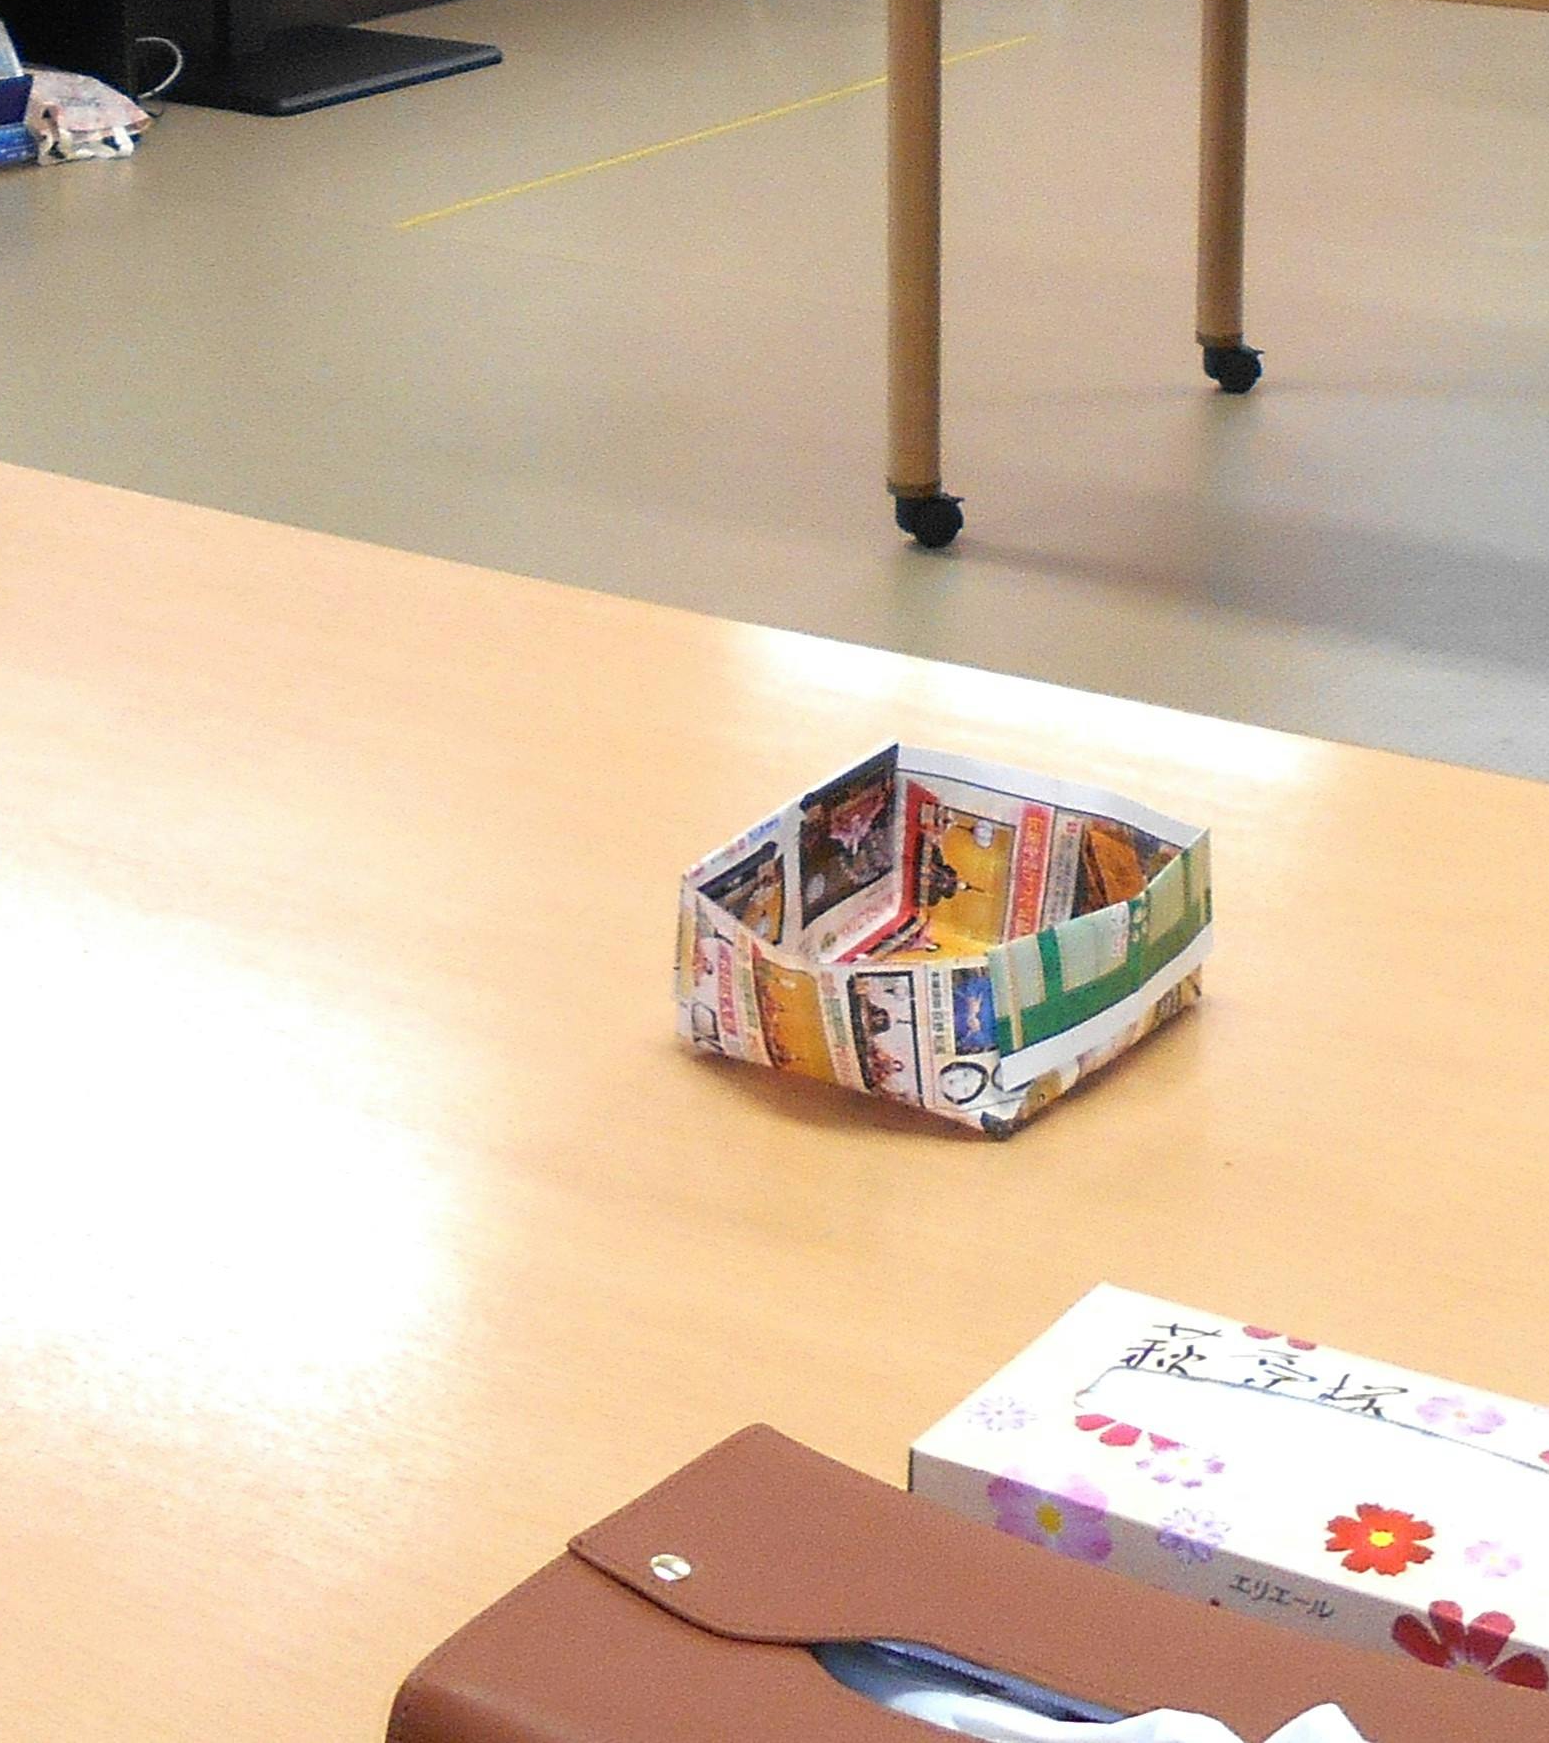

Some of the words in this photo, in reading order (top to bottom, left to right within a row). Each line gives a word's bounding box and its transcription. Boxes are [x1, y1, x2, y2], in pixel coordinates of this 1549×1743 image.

[1228, 1573, 1336, 1618] エリエール
